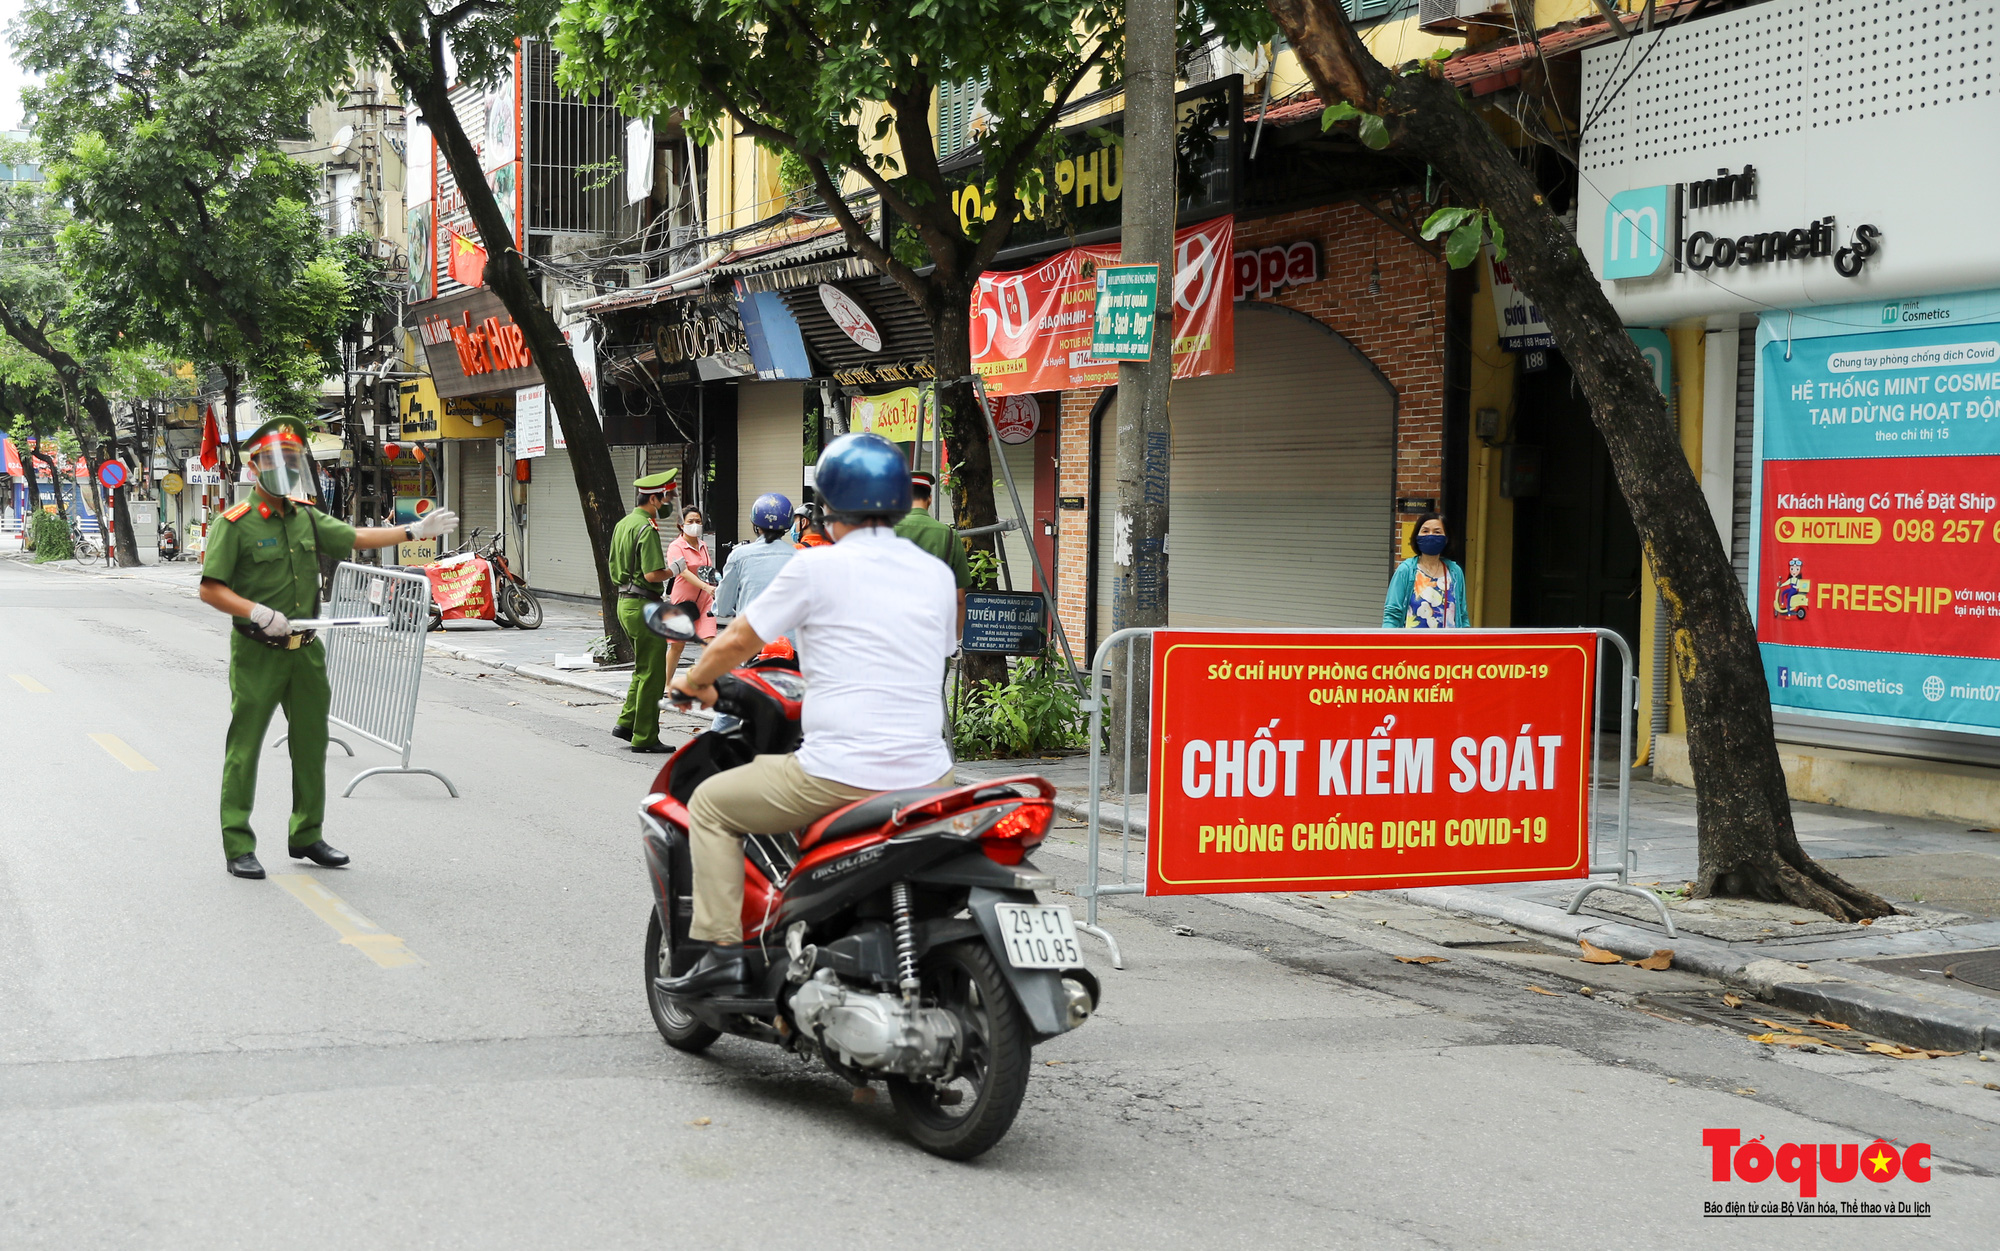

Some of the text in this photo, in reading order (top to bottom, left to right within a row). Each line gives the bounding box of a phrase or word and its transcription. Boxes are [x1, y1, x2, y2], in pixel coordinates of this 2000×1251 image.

[1055, 145, 1123, 213] PHU
[1690, 164, 1757, 209] mint
[1686, 215, 1883, 278] Cosmetics
[1233, 242, 1317, 301] ppa
[1902, 308, 1950, 322] Cosmetics
[1903, 301, 1919, 310] mint
[1509, 338, 1523, 348] Add:
[1524, 338, 1534, 347] 188
[1535, 337, 1549, 348] Hang
[1525, 352, 1544, 369] 188
[1833, 348, 1995, 370] Chung tay phòng chống dịch Covid
[877, 368, 905, 382] KEM
[1084, 369, 1119, 383] hoang-phuc.
[1791, 372, 2000, 404] HỆ THỐNG MINT COSME
[1809, 396, 2000, 429] TẠM DỪNG HOẠT ĐỘN
[1875, 428, 1949, 442] theo chỉ thị 15
[1777, 490, 1996, 513] Khách Hàng Có Thể Đặt Ship
[1801, 521, 1874, 539] HOTLINE
[1892, 519, 1935, 543] 098
[1941, 519, 1985, 543] 257
[1816, 583, 1995, 615] FREESHIP VỚI MỌI
[967, 606, 1039, 623] TUYẾN PHỐ CẤM
[1954, 605, 1985, 618] tại nội
[1208, 655, 1548, 685] SỞ CHỈ HUY PHÒNG CHỐNG DỊCH COVID-19
[1309, 684, 1453, 707] QUẬN HOÀN KIẾM
[1791, 671, 2000, 702] Mint Cosmetics mint07
[1181, 714, 1561, 798] CHỐT KIỂM SOÁT
[1198, 813, 1547, 854] PHÒNG CHỐNG DỊCH COVID-19
[1013, 938, 1078, 964] 110.85
